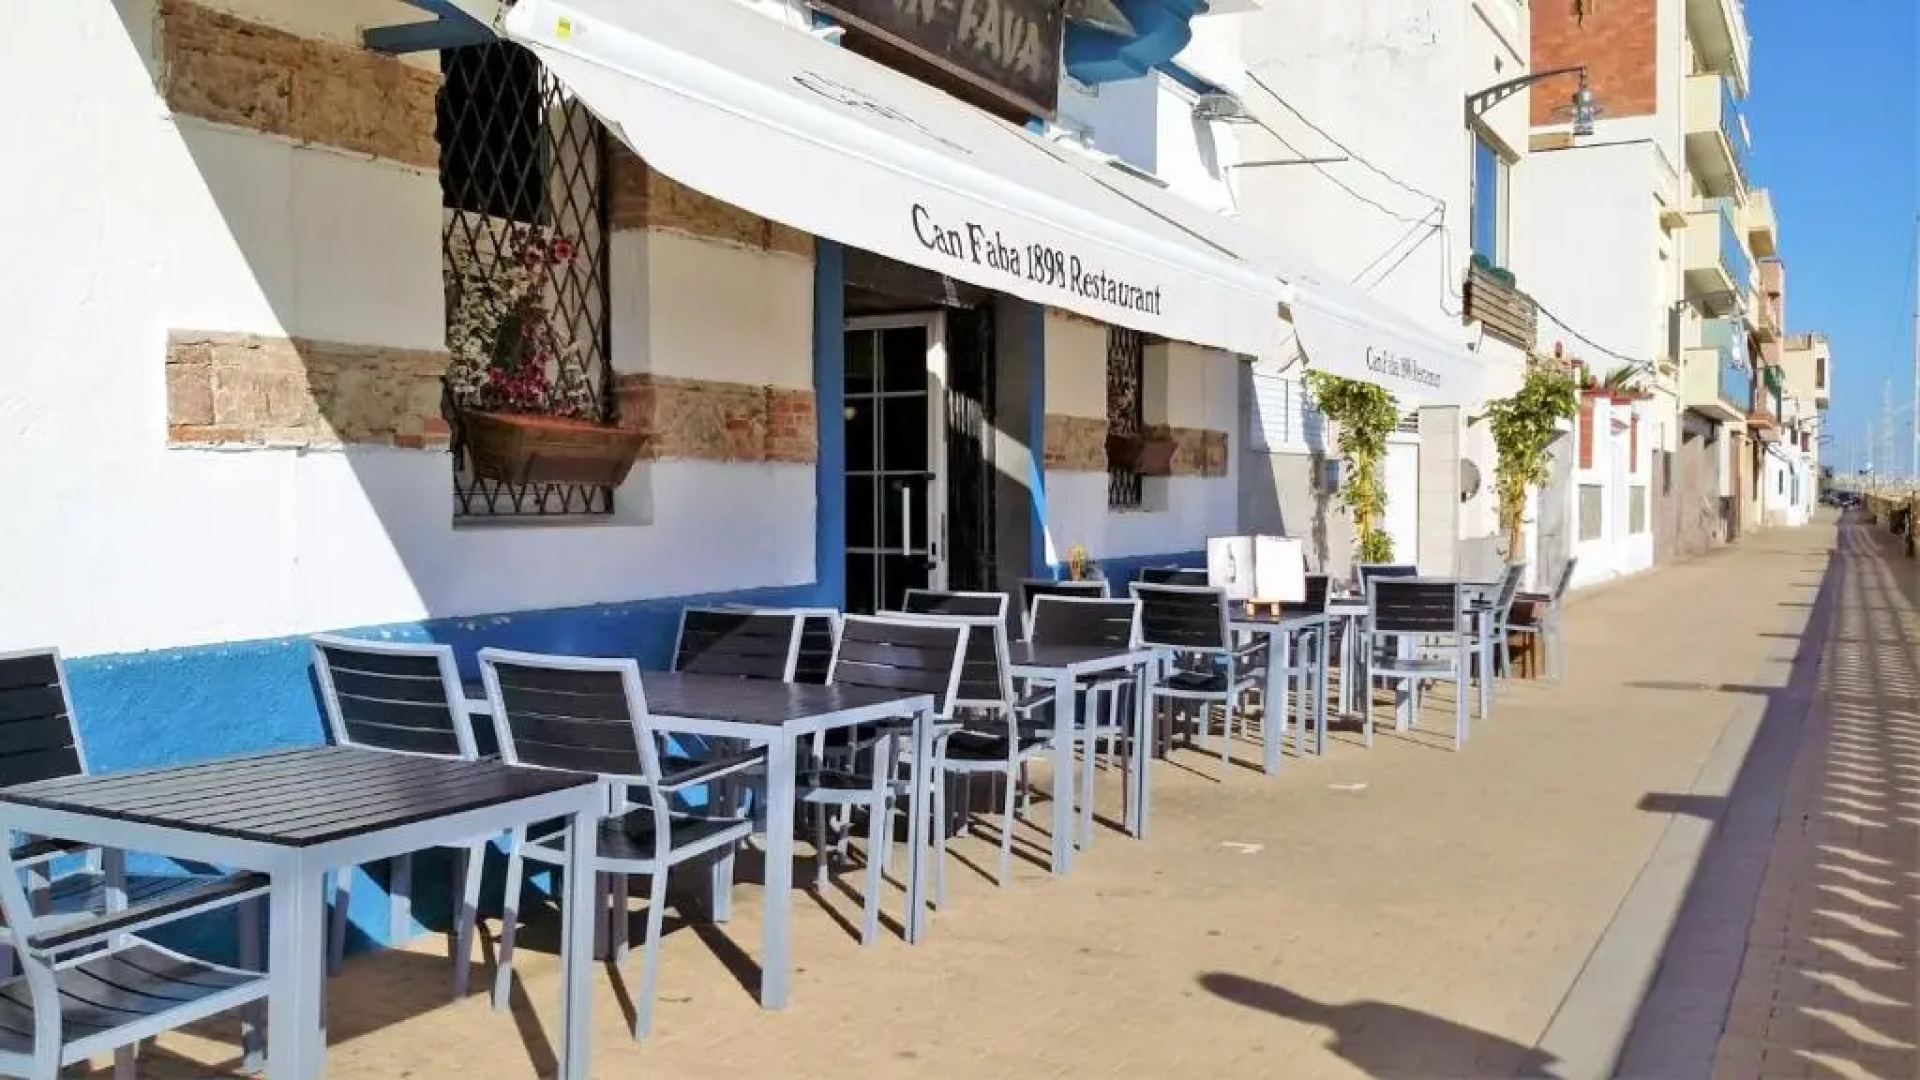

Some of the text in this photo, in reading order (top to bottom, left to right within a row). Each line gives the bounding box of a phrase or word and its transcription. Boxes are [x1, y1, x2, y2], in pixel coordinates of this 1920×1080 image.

[911, 203, 1162, 315] Can Faba 1898 Restaurant
